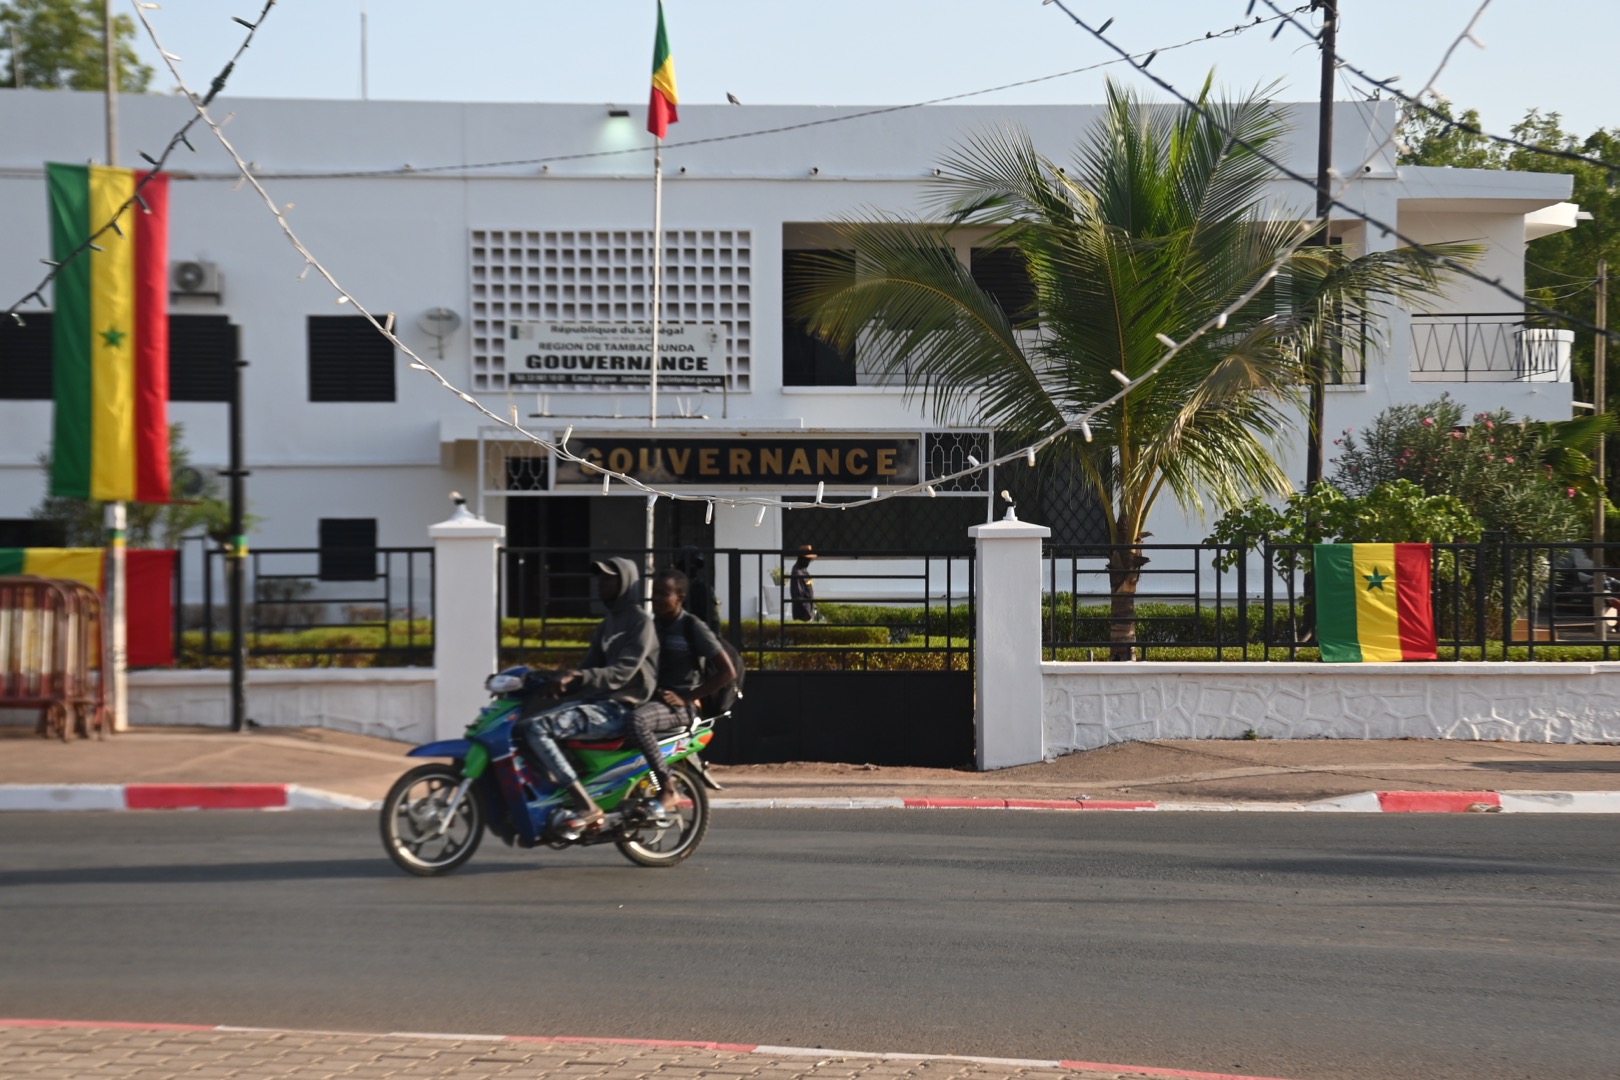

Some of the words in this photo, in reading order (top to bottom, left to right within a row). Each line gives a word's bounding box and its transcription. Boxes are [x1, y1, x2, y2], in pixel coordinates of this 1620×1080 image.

[550, 325, 617, 335] République
[620, 326, 635, 334] du
[638, 326, 684, 336] Séégal
[586, 343, 602, 351] DE
[604, 343, 695, 352] TAMBACUNDA
[579, 447, 898, 476] GOUVERNANCE
